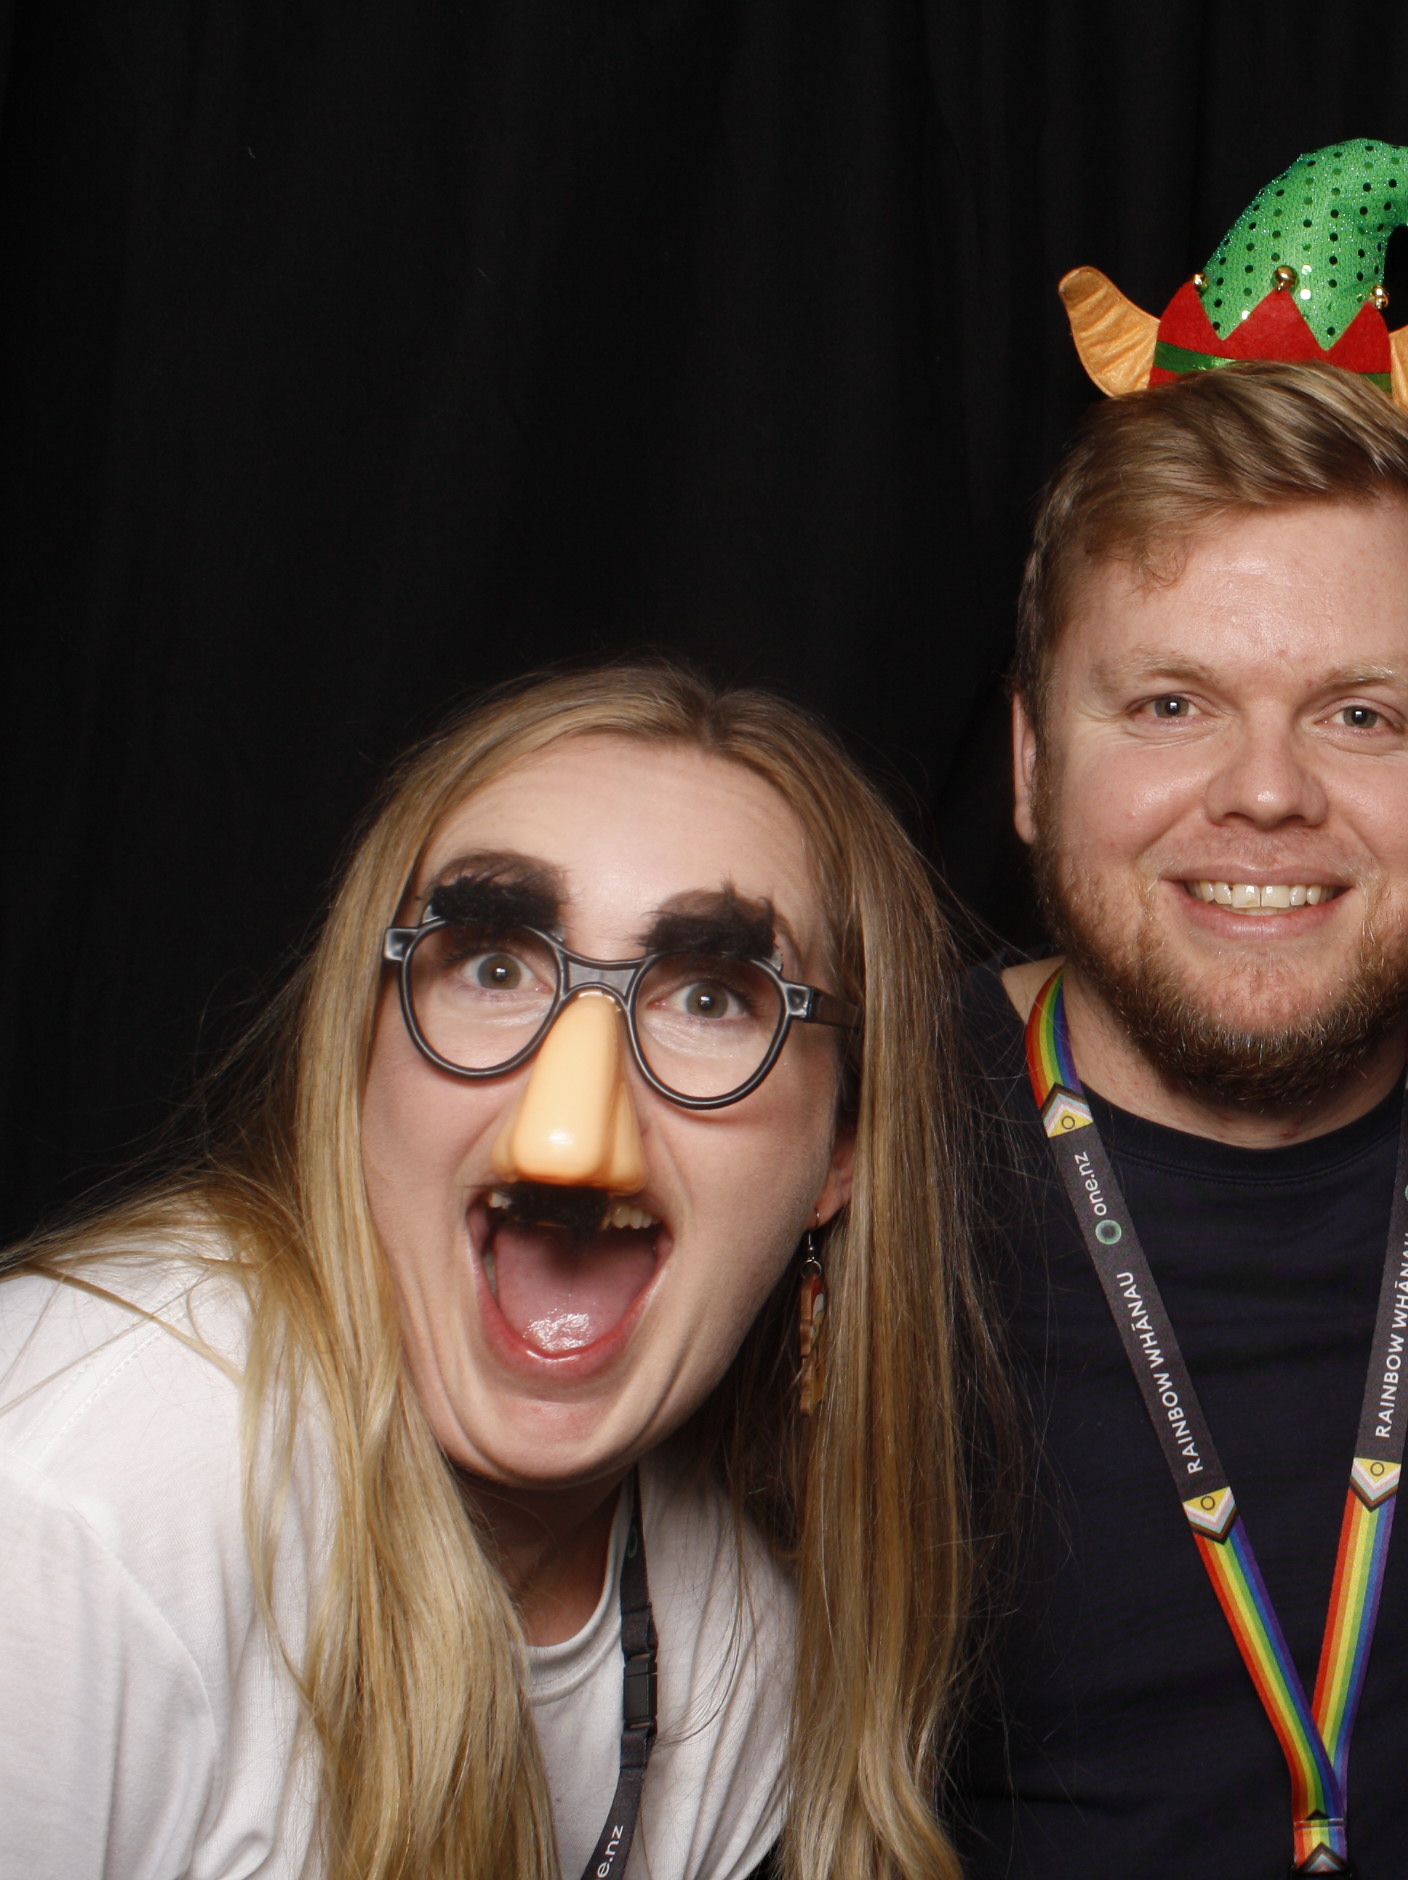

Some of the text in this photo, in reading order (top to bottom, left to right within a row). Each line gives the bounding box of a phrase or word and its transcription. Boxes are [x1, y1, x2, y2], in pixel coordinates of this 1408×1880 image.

[1074, 1151, 1108, 1217] one.nz
[1116, 1271, 1204, 1474] RAINBOW WHĀNAU
[1374, 1333, 1405, 1438] RAINBOW
